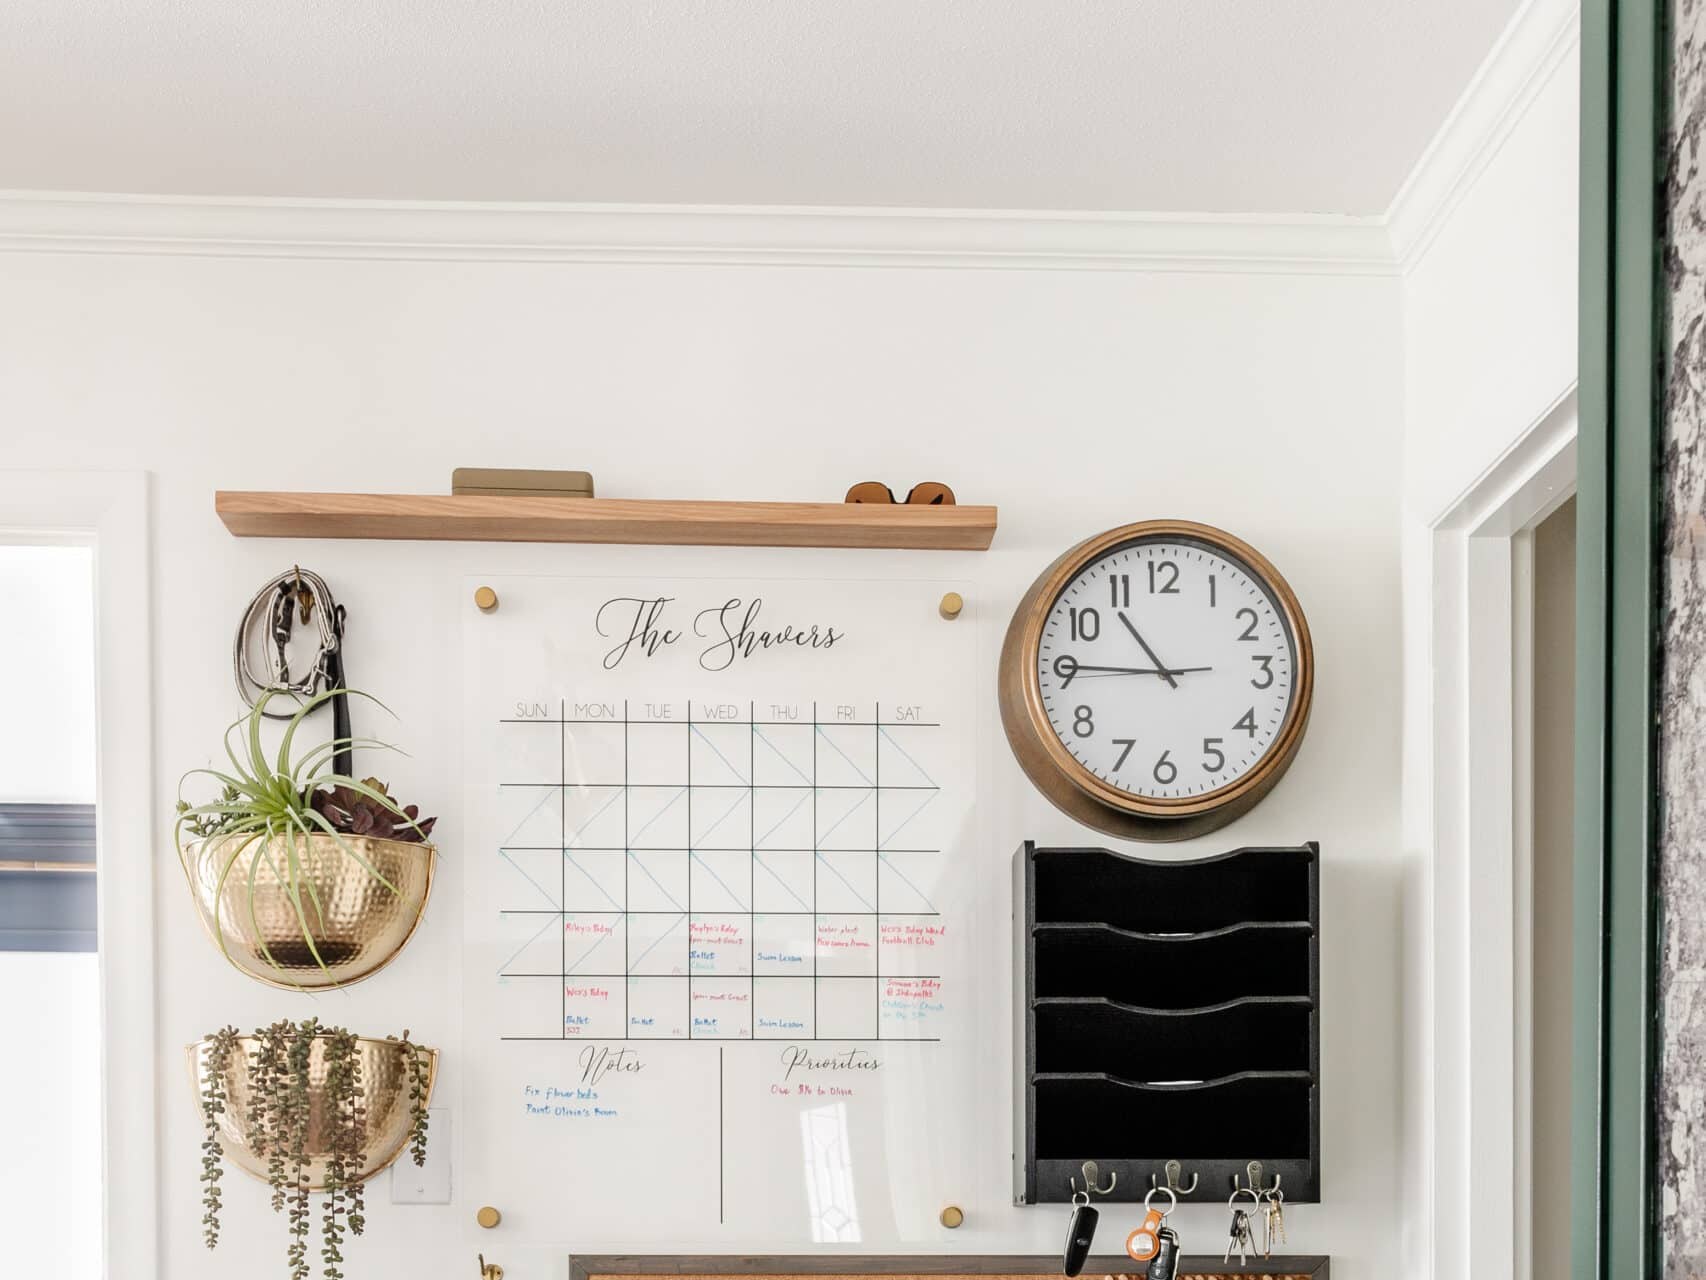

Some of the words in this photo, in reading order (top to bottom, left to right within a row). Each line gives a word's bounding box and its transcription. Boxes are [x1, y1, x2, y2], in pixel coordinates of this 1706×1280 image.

[1109, 574, 1130, 608] 11
[1148, 560, 1180, 594] 12
[1208, 574, 1216, 608] 1
[595, 596, 682, 670] The
[693, 597, 844, 671] Shavers
[1069, 607, 1100, 642] 10
[1235, 607, 1259, 641] 2
[1053, 654, 1078, 689] 9
[1250, 655, 1274, 690] 3
[515, 702, 548, 718] SUN
[574, 703, 615, 719] MON
[644, 703, 672, 719] TUE
[702, 704, 739, 720] WED
[770, 704, 798, 720] THU
[836, 705, 856, 720] FRI
[895, 705, 922, 721] SAT
[1072, 704, 1094, 738] 8
[1231, 705, 1259, 738] 4
[1111, 738, 1136, 772] 7
[1153, 750, 1178, 785] 6
[1201, 737, 1225, 773] 5
[578, 1044, 647, 1086] Notes
[781, 1045, 884, 1081] Priorities
